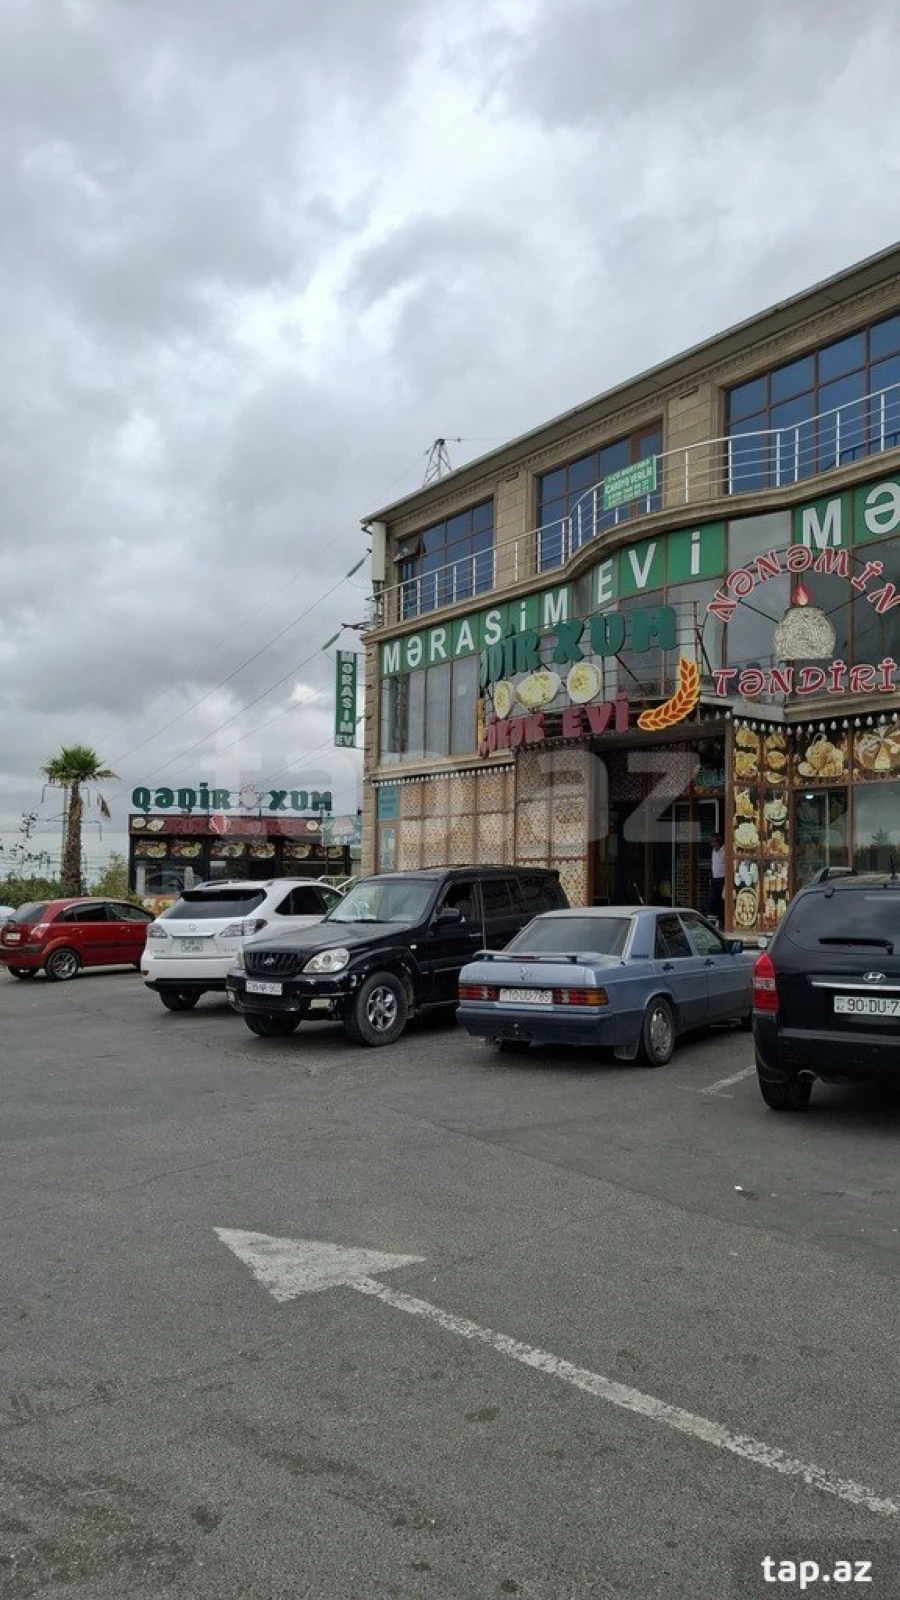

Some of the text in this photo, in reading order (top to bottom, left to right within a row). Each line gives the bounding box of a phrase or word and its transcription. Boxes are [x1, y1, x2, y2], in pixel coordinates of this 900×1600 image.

[552, 606, 677, 665] XUM
[712, 657, 897, 698] TƏNDİRİ
[562, 690, 630, 738] EVİ
[268, 790, 333, 812] XUM
